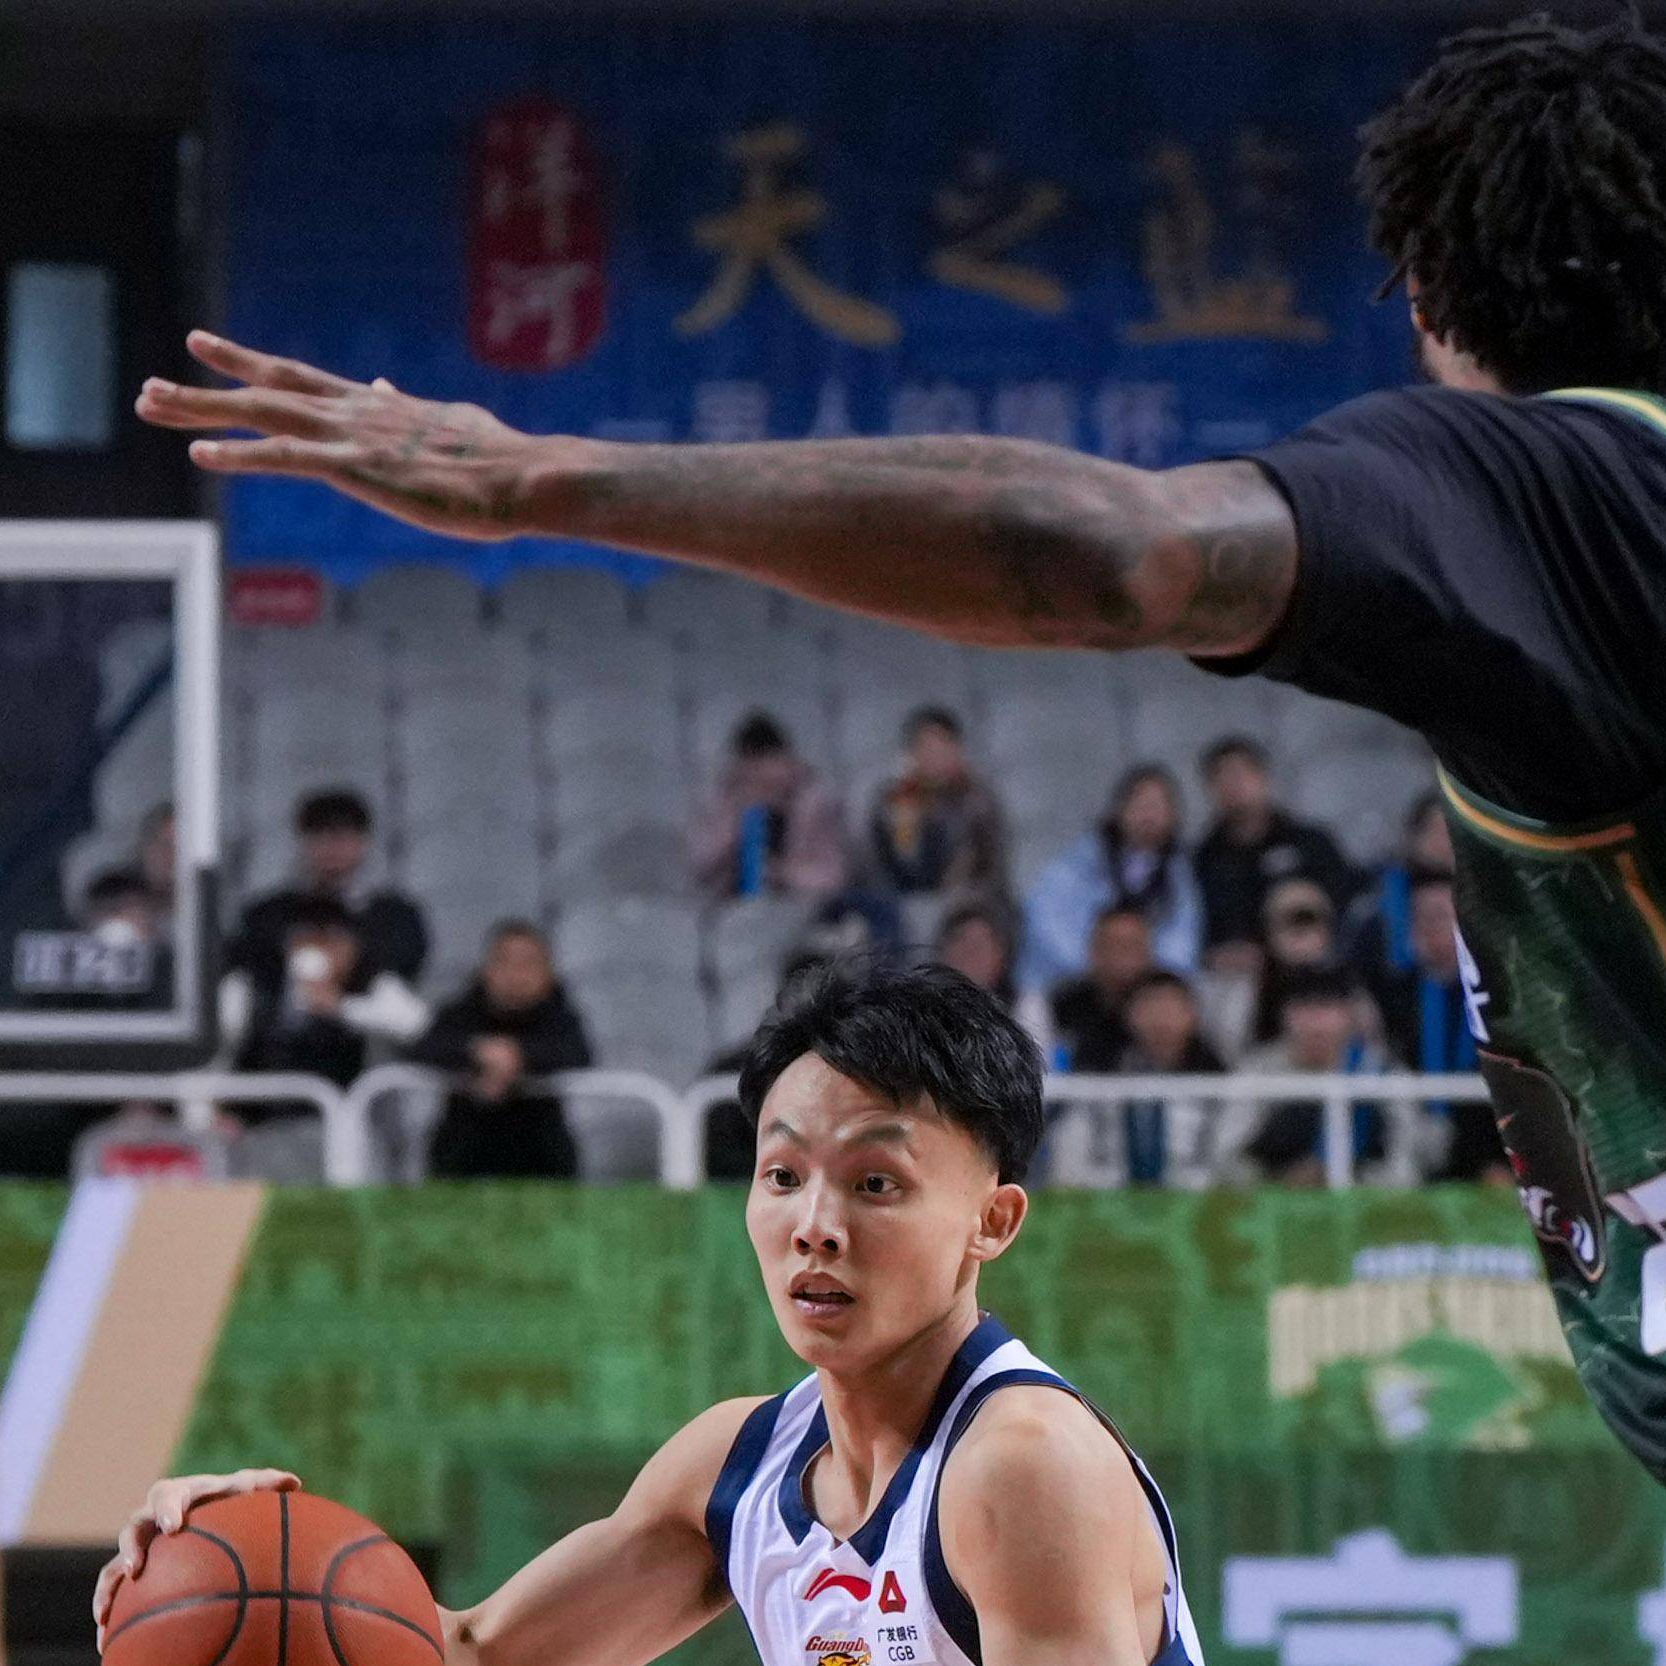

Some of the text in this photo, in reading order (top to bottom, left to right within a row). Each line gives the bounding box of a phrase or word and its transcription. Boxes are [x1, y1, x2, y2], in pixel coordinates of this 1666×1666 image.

[877, 1625, 918, 1643] 广发银行
[888, 1645, 916, 1662] CGB
